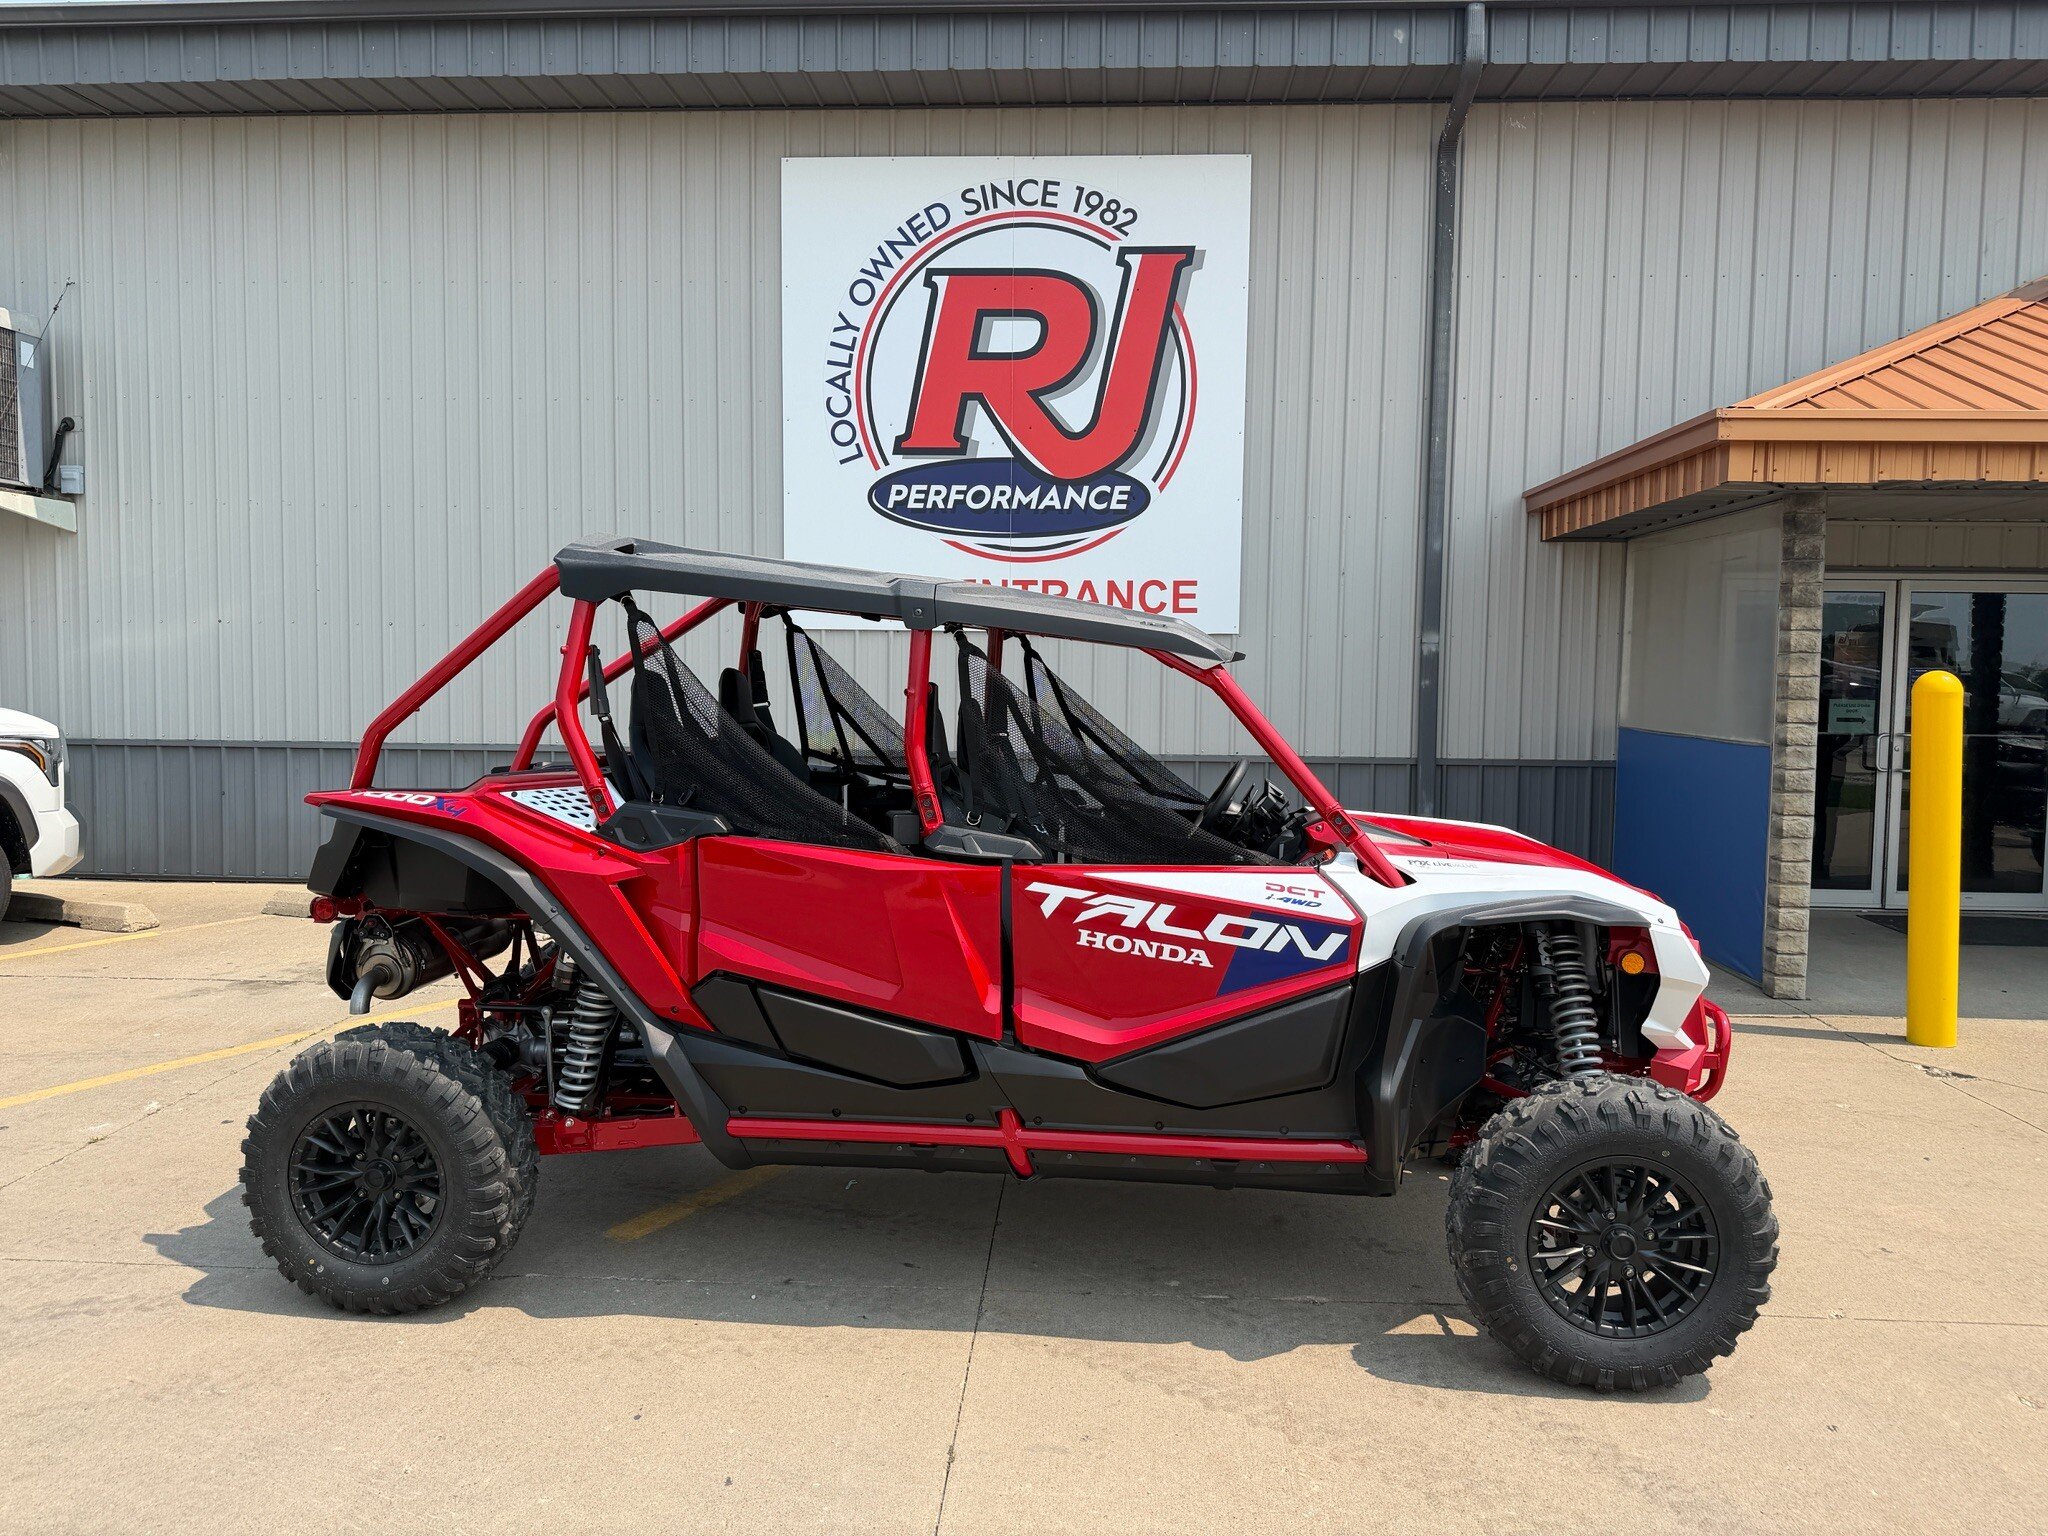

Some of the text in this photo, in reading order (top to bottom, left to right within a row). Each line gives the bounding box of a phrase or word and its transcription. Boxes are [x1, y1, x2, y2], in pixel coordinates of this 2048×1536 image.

[826, 178, 1139, 466] LOCALLY OWNED SINCE 1982
[892, 245, 1197, 484] RJ
[886, 484, 1132, 512] PERFORMANCE
[962, 579, 1198, 614] RANCE
[1265, 882, 1326, 899] DCT
[1024, 881, 1348, 961] TALON
[1076, 928, 1214, 969] HONDA
